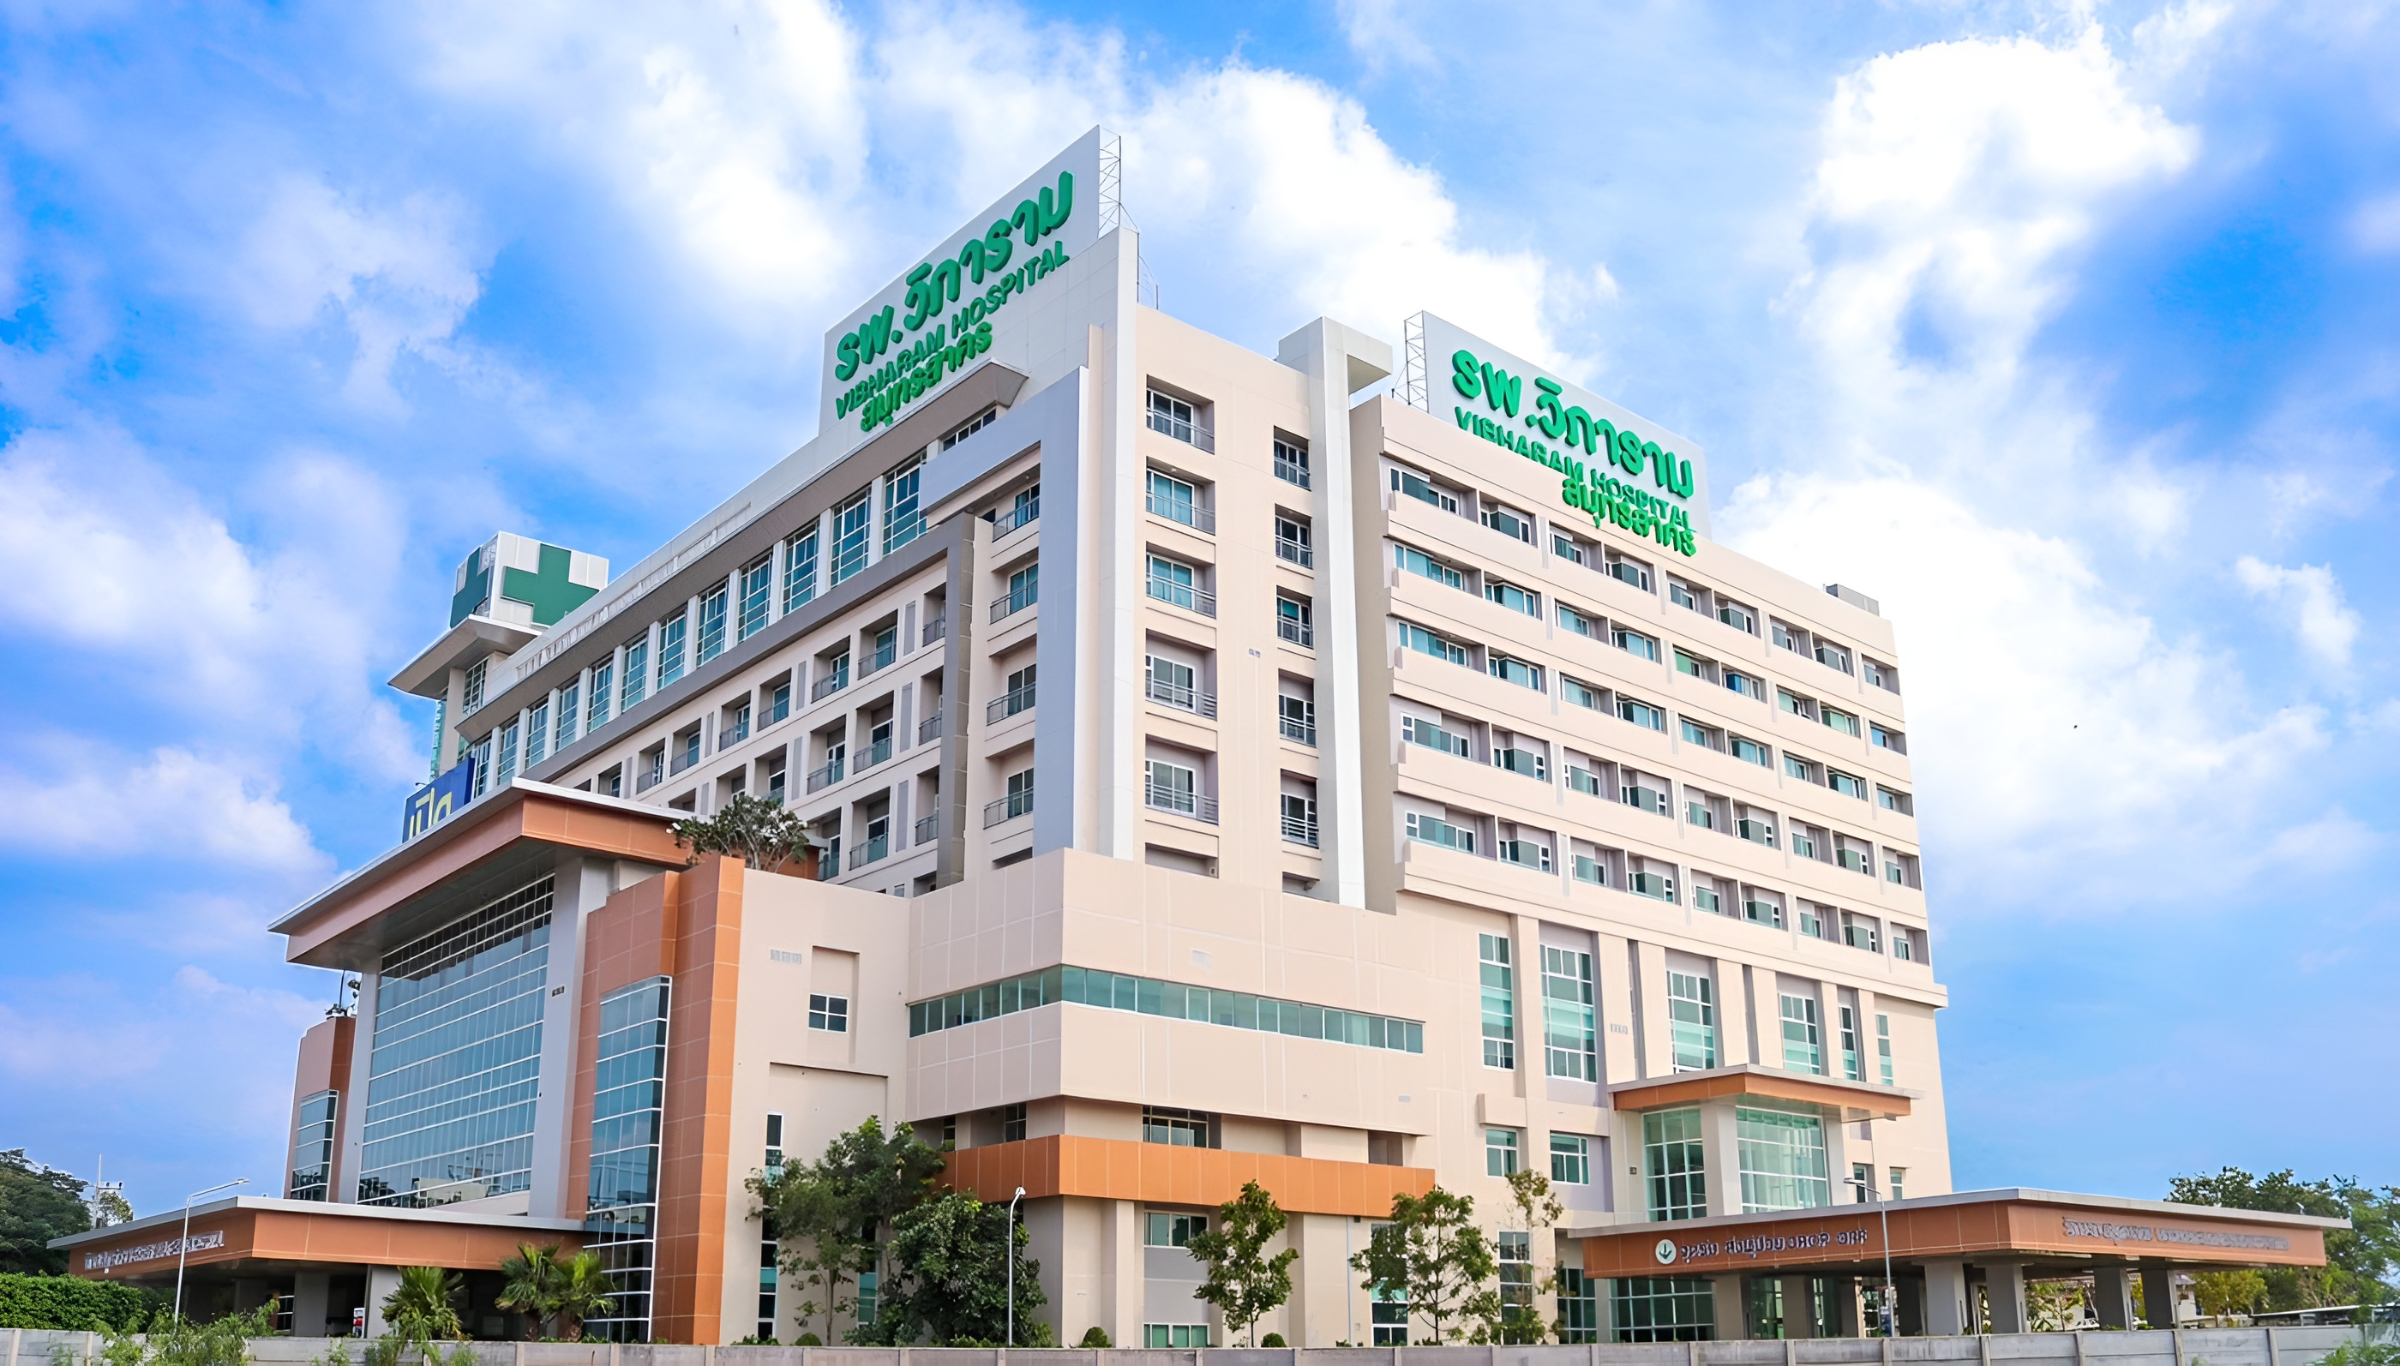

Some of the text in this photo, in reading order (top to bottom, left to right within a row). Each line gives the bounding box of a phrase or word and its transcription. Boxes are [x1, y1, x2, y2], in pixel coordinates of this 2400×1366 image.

[836, 240, 1070, 420] VIBHARAM HOSPITAL
[1454, 406, 1697, 533] VIBHARAM HOSPITAL
